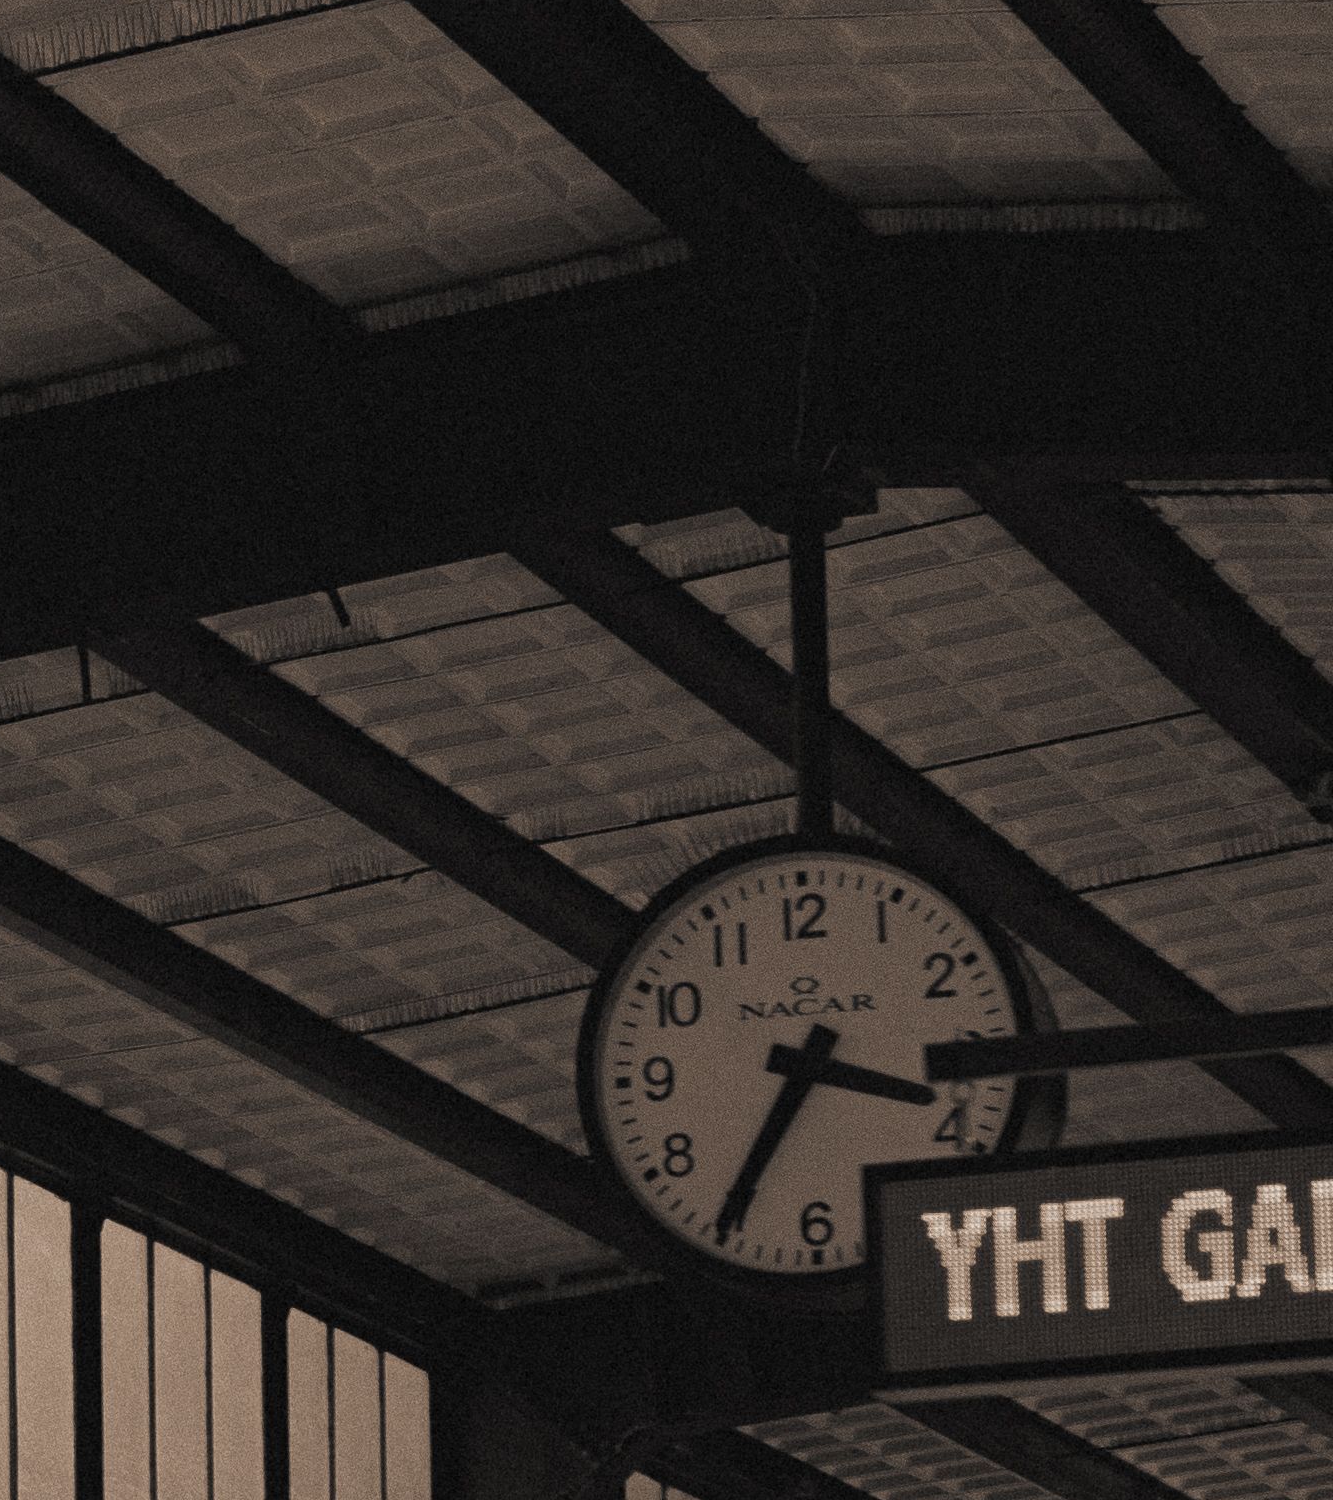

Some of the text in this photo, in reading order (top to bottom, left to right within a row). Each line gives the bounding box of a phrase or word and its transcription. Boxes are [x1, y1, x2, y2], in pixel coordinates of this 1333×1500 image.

[784, 893, 828, 941] 12
[877, 900, 887, 943] 1
[713, 922, 748, 967] 11
[923, 952, 957, 999] 2
[657, 981, 701, 1028] 10
[738, 994, 877, 1021] NACAR
[643, 1056, 674, 1102] 9
[934, 1100, 968, 1149] 4
[664, 1133, 695, 1178] 8
[800, 1201, 833, 1247] 6
[919, 1197, 1125, 1322] YHT
